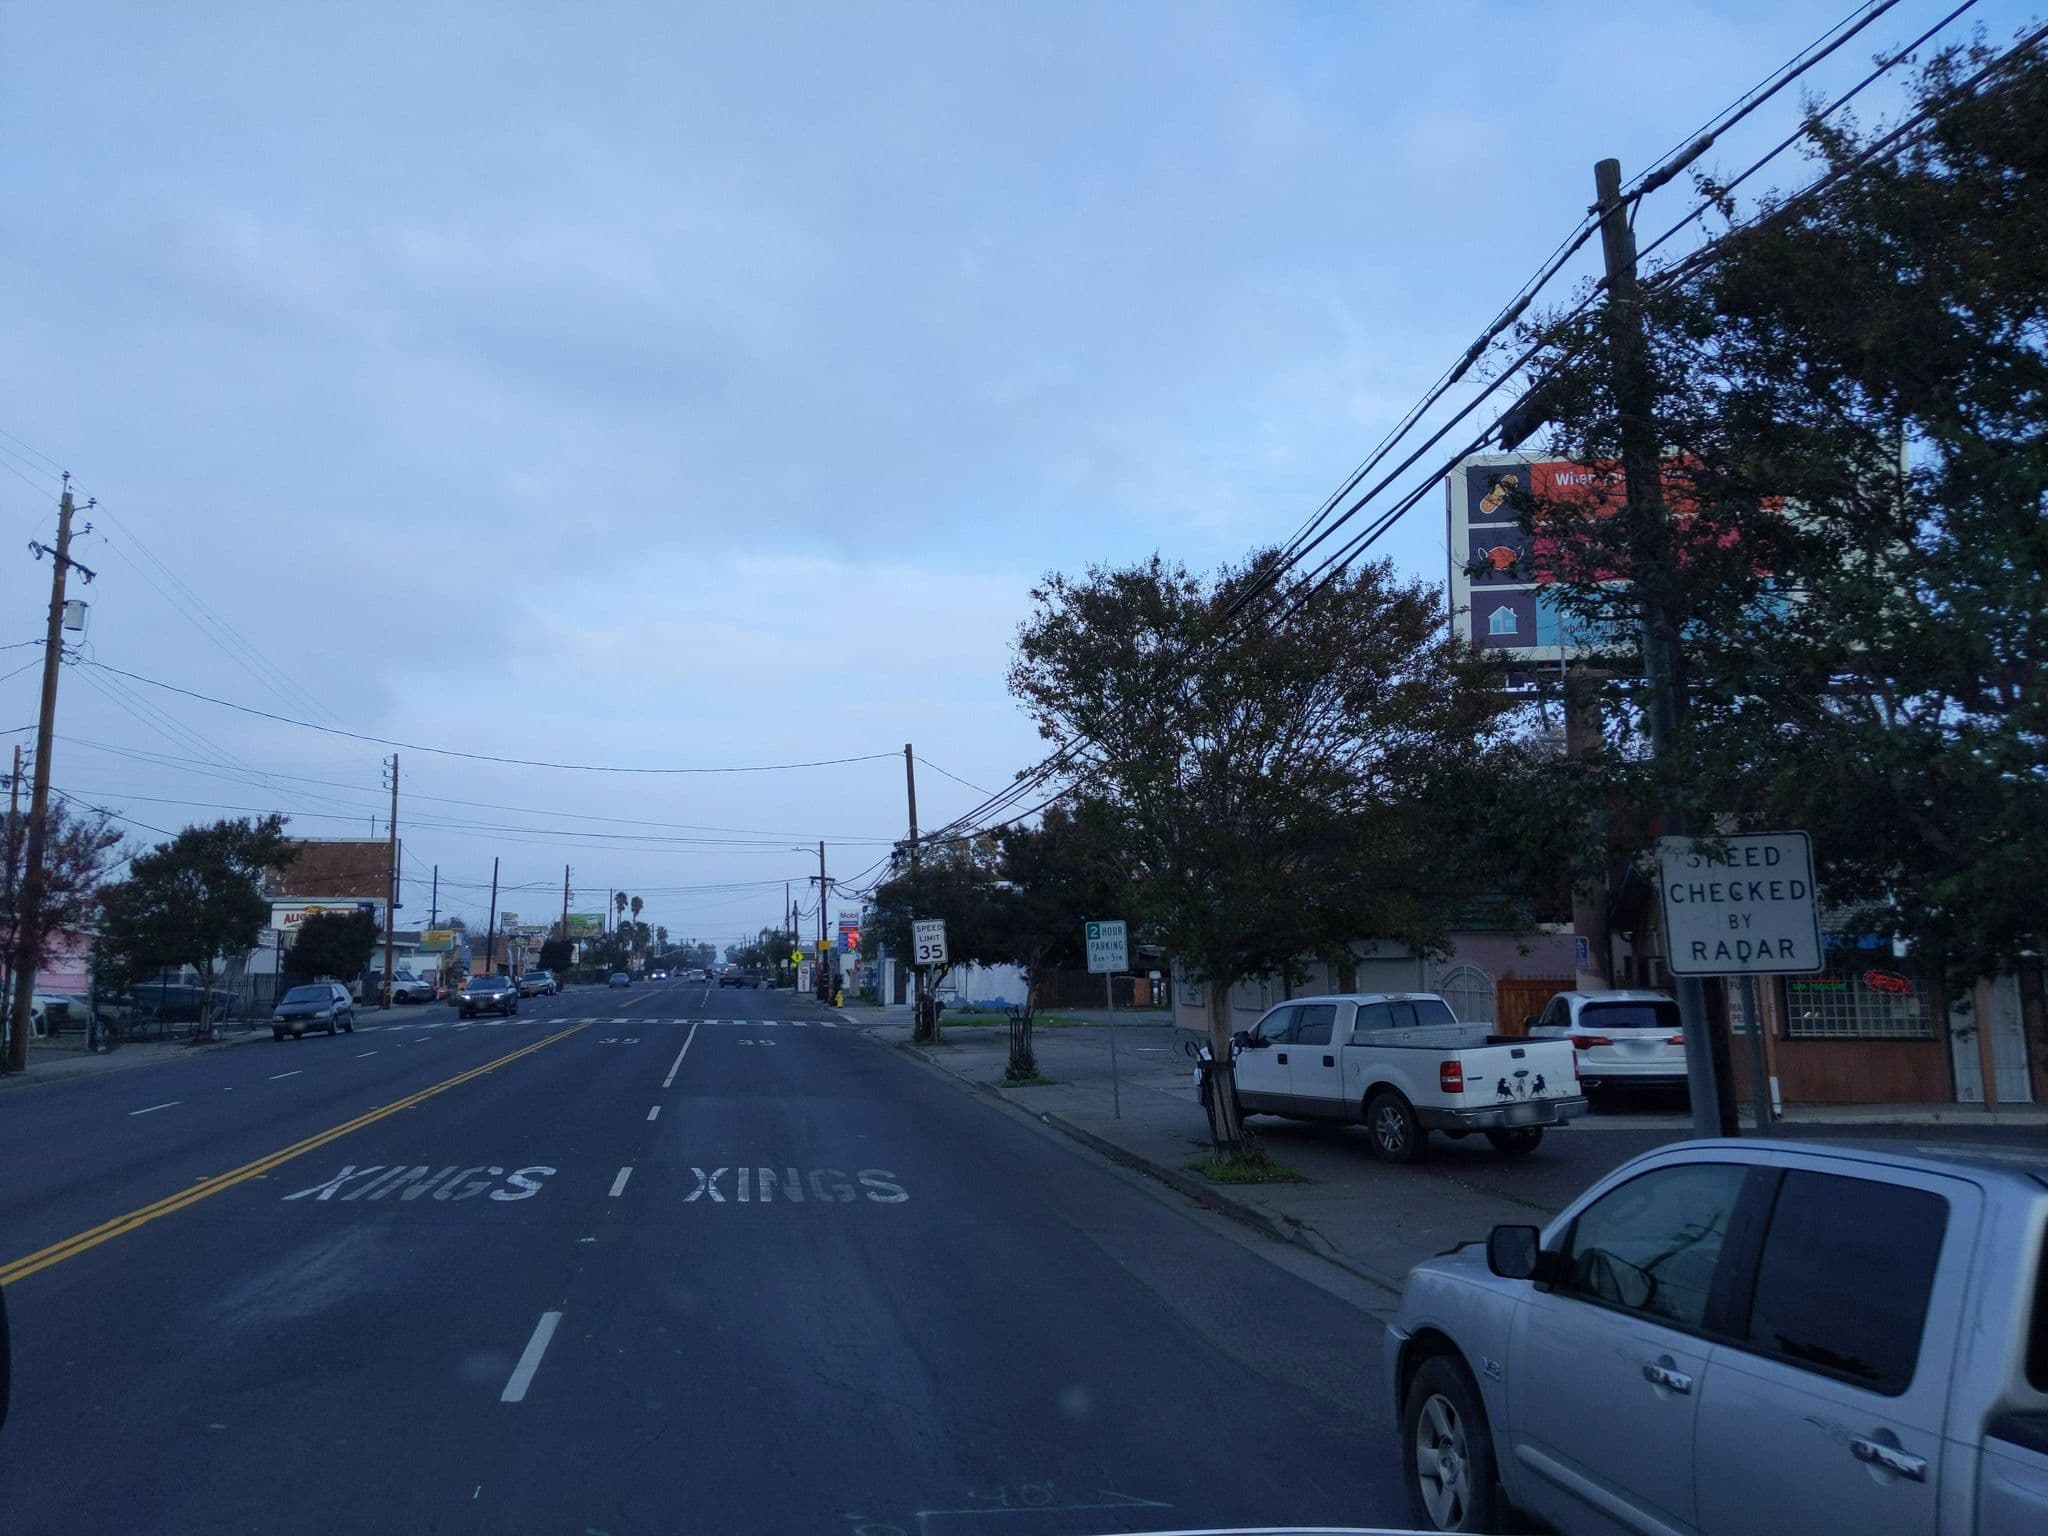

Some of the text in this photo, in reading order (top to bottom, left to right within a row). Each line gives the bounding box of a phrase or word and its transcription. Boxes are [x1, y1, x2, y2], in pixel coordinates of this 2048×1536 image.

[1670, 880, 1806, 903] CHECKED
[916, 924, 943, 932] SPEED
[1728, 913, 1752, 929] BY
[919, 934, 940, 942] LIMIT
[1090, 926, 1123, 938] 2 HOUR
[919, 944, 943, 960] 35
[1091, 941, 1123, 951] PARKING
[1692, 939, 1795, 961] RADAR
[738, 1038, 776, 1046] 35
[281, 1165, 557, 1201] XINGS
[685, 1167, 911, 1203] XINGS
